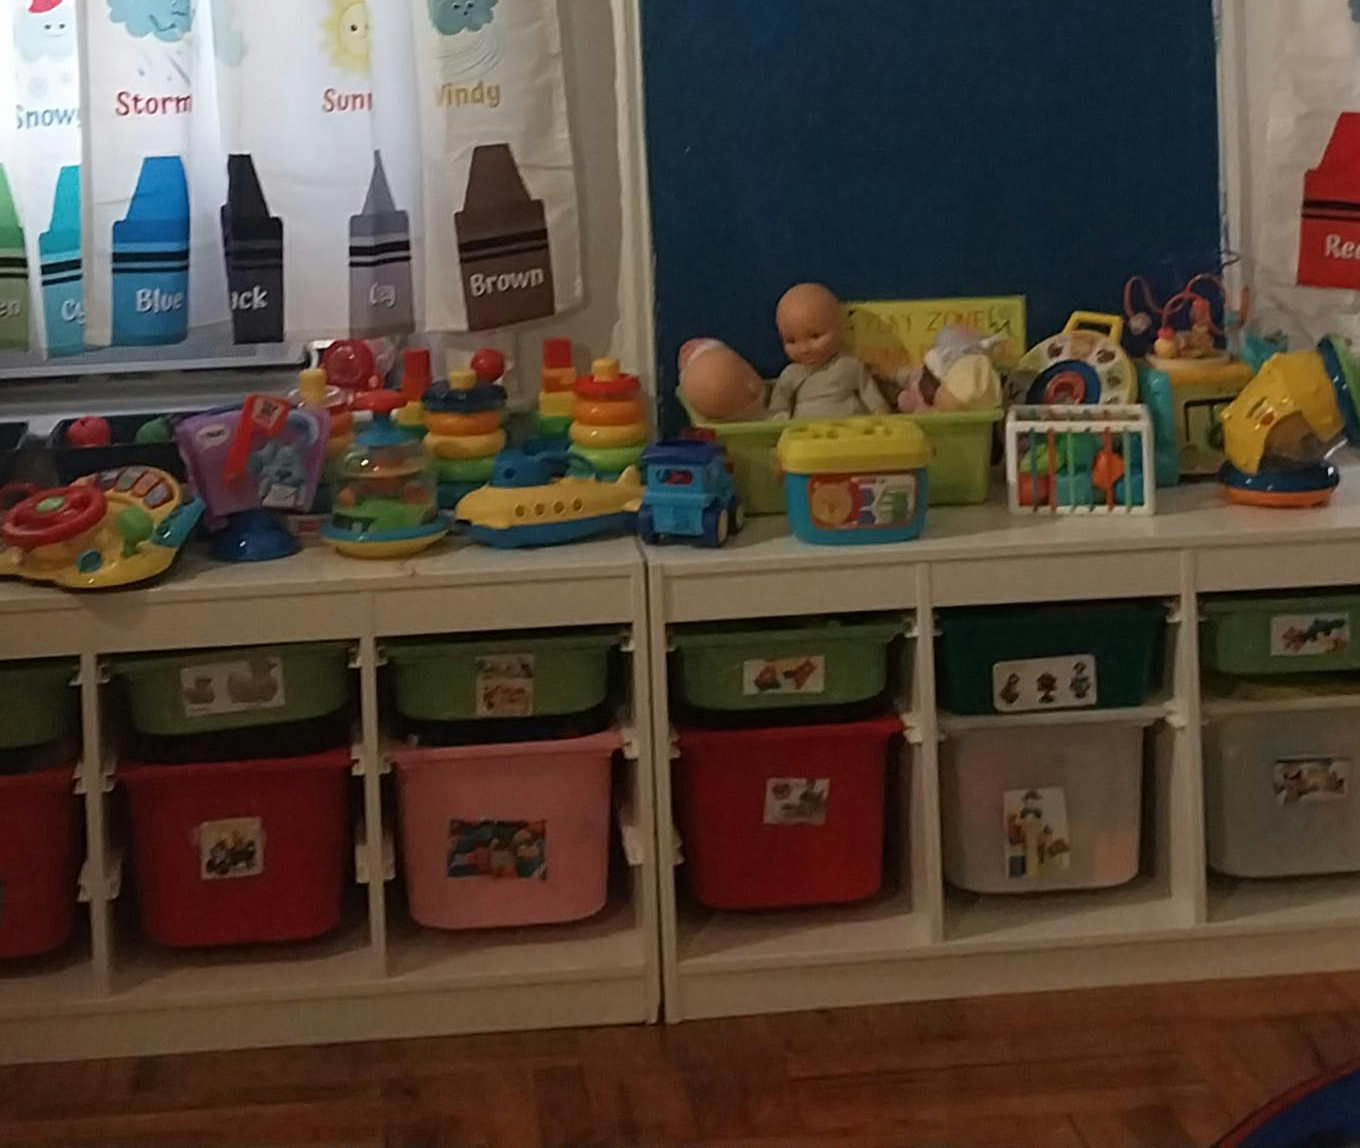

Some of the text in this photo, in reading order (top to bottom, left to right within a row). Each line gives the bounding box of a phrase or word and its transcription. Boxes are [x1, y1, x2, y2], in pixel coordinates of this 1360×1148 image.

[114, 90, 193, 117] Storm
[469, 266, 545, 299] Brown
[135, 286, 184, 313] Blue
